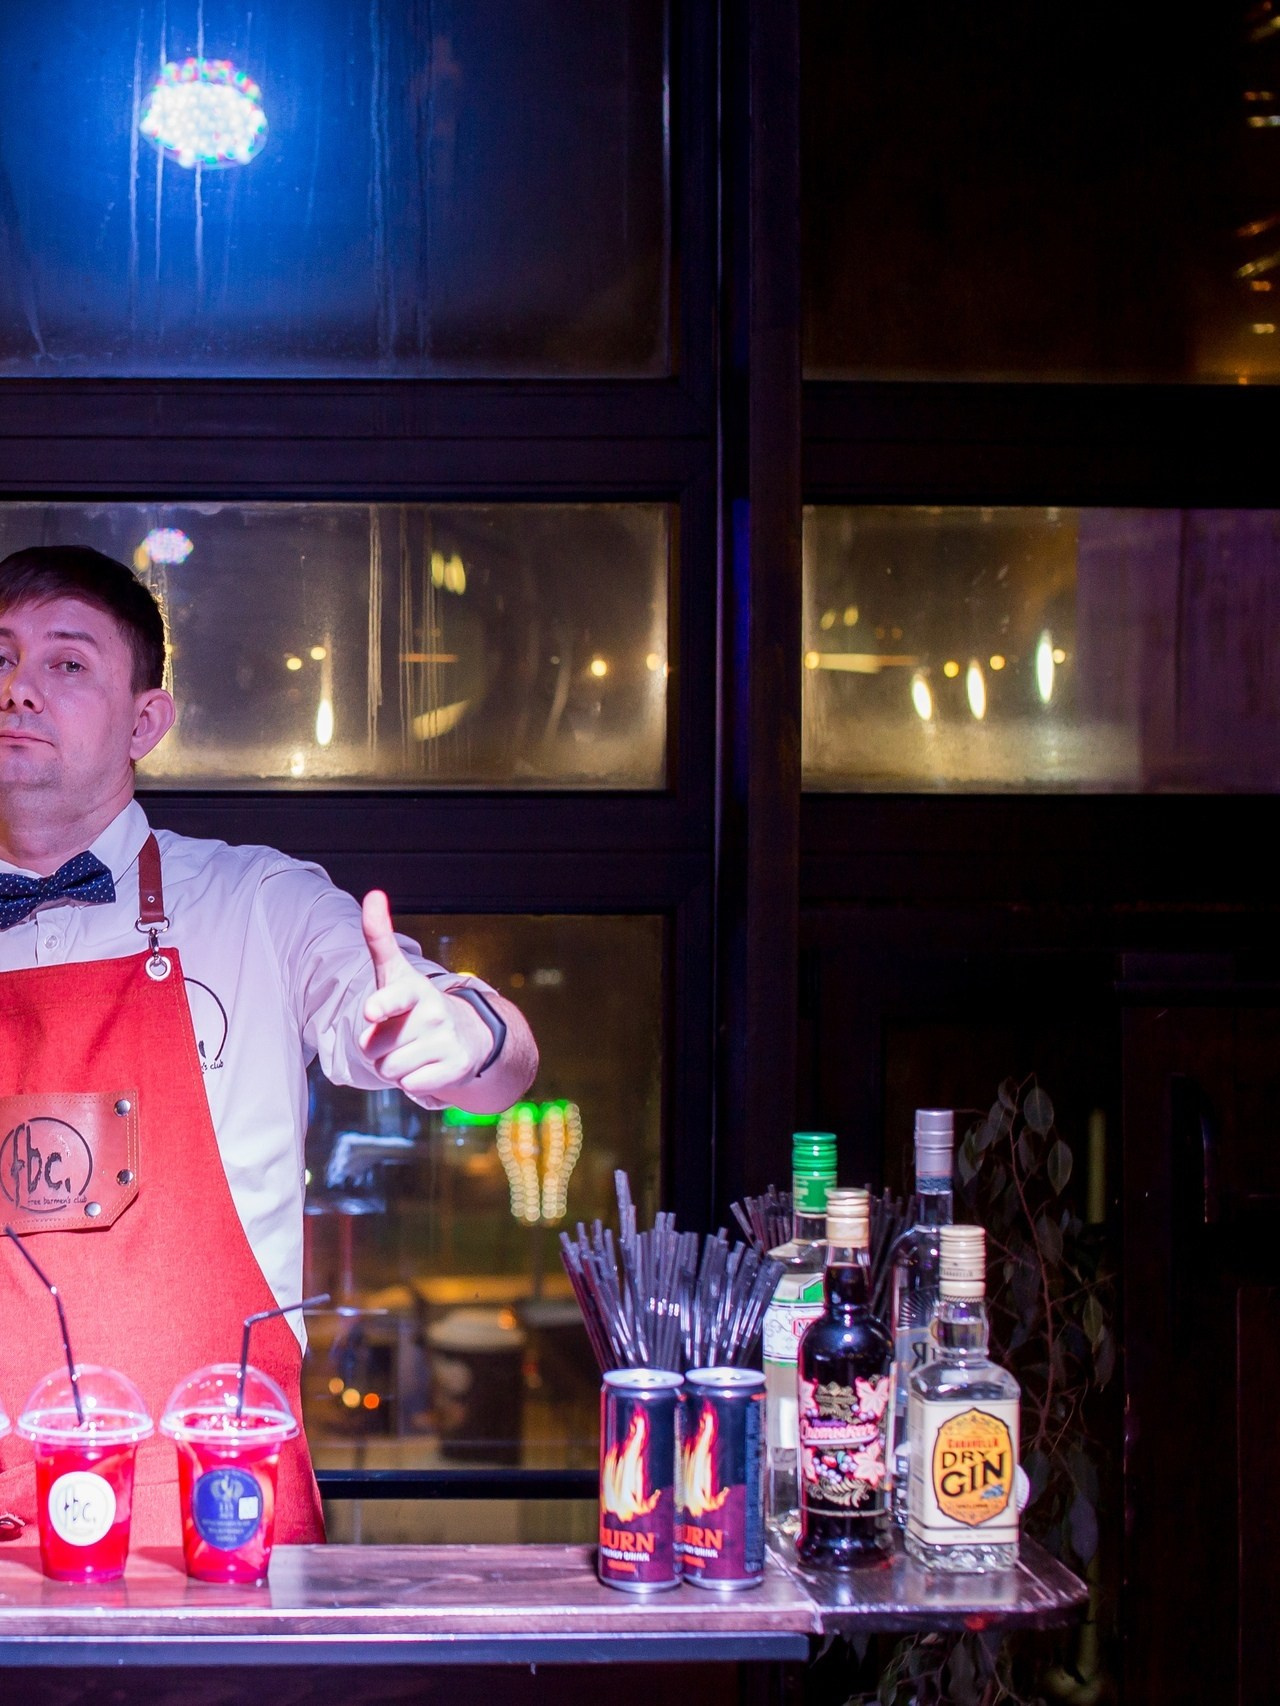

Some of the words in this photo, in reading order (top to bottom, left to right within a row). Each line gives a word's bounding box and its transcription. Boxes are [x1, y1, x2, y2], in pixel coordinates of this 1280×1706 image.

[43, 1195, 71, 1205] barmen's
[73, 1195, 87, 1204] club
[941, 1450, 991, 1470] DRY
[940, 1450, 1007, 1498] GIN
